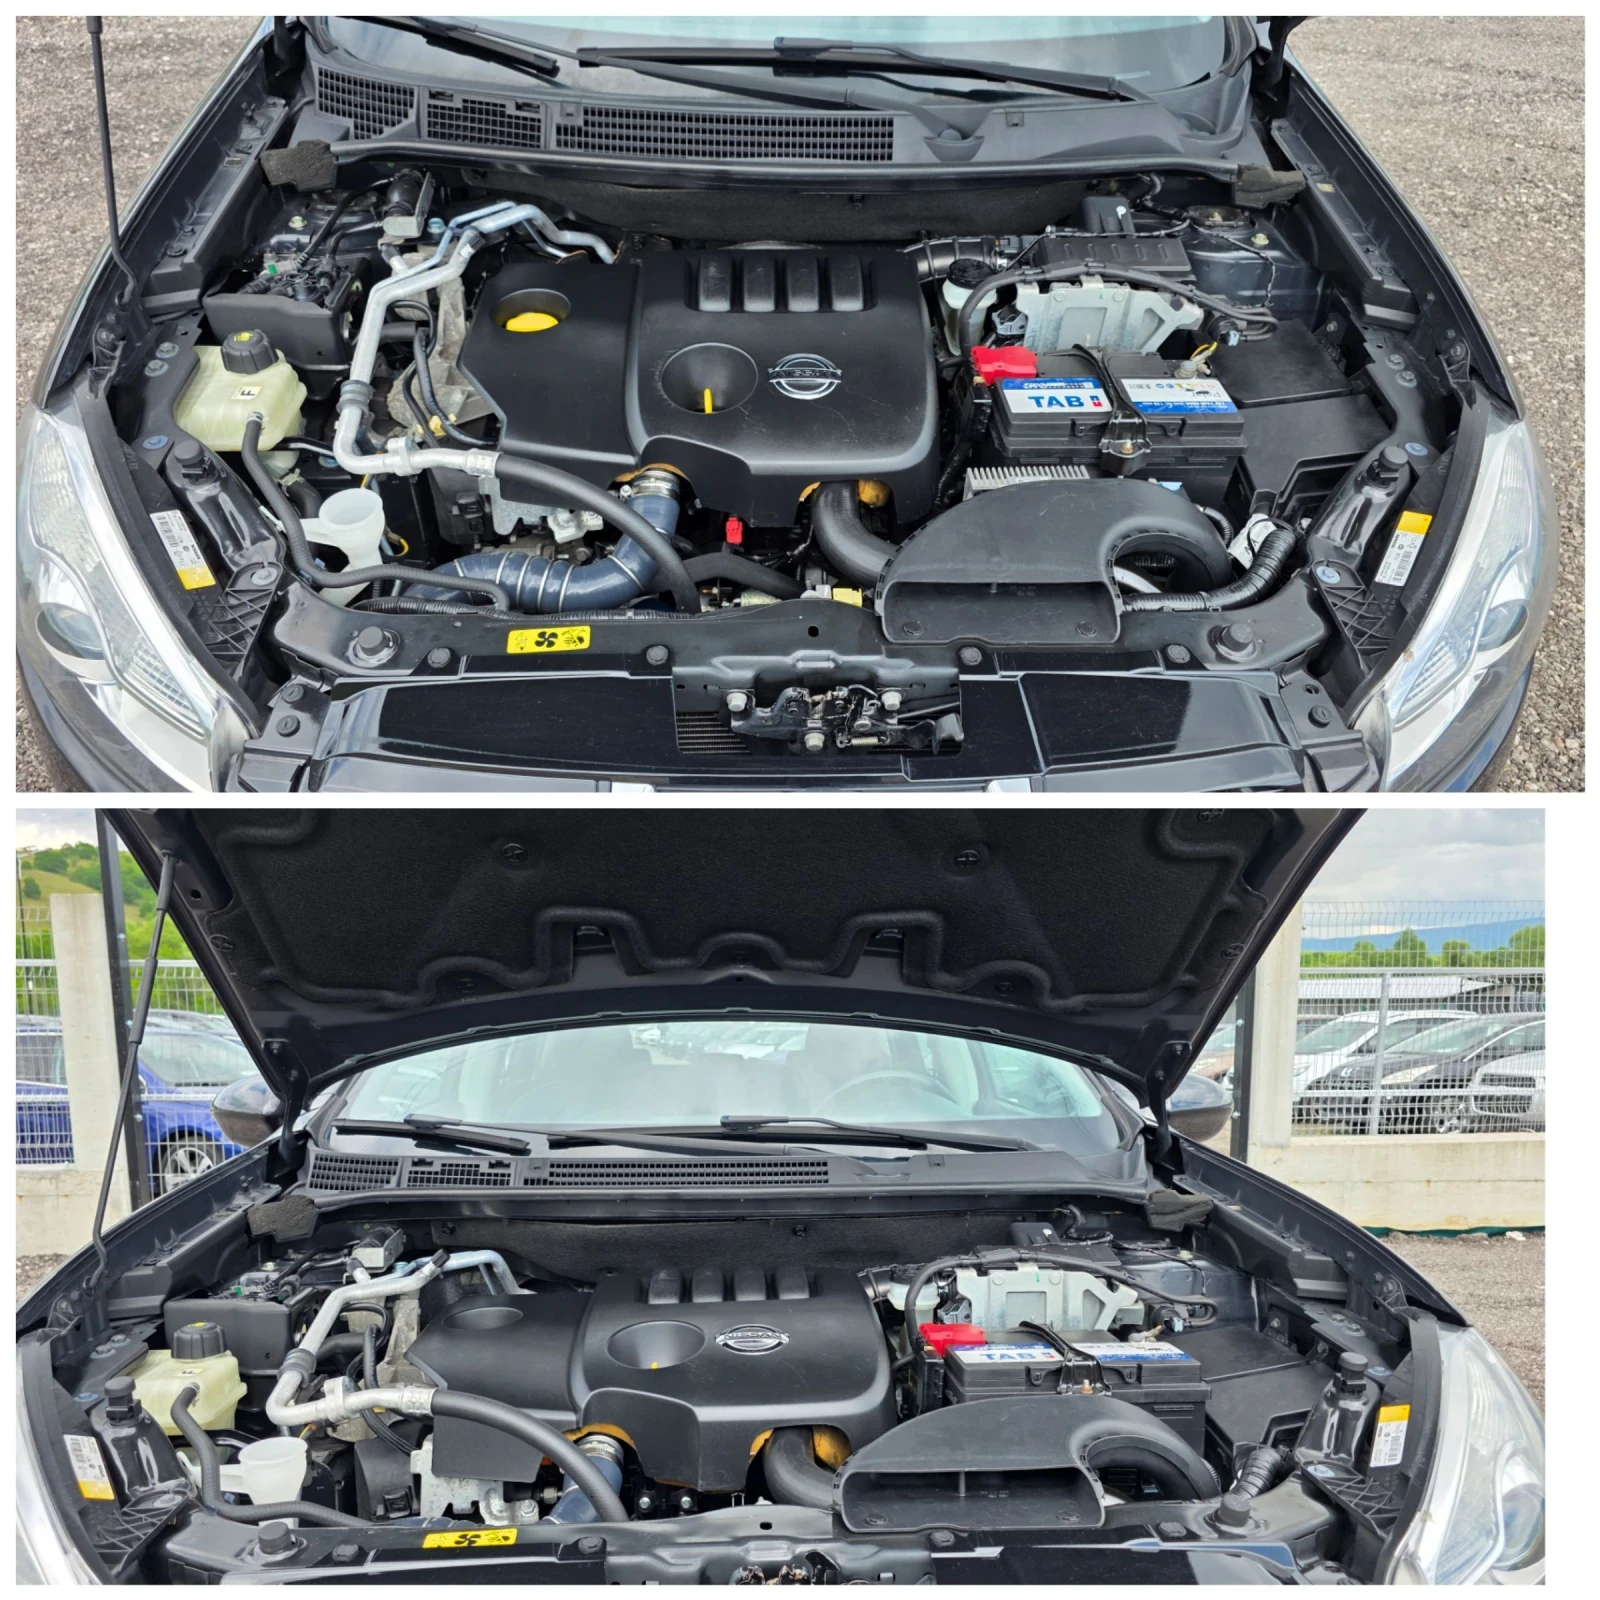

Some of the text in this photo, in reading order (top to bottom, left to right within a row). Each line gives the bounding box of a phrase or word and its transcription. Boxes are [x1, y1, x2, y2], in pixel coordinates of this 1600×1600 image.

[239, 388, 256, 397] F
[1027, 395, 1085, 408] TAB
[979, 1352, 1037, 1361] TAB
